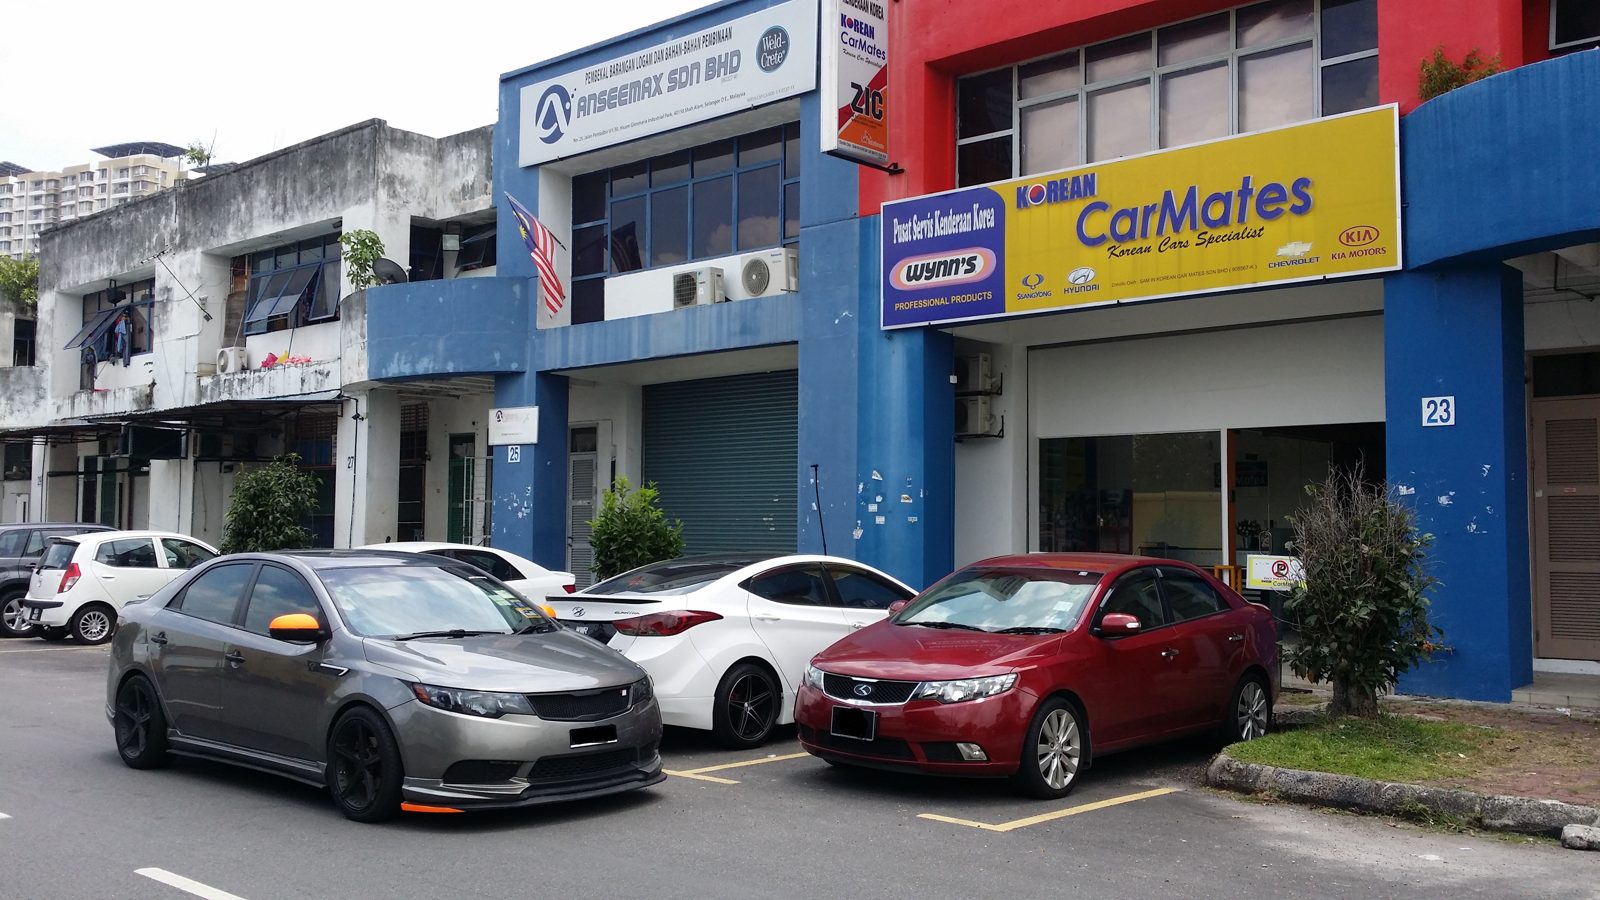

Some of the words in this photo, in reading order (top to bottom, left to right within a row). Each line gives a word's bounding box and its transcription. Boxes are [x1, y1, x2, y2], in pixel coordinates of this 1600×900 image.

[870, 1, 884, 20] KOREA
[841, 13, 875, 40] KOREAN
[762, 32, 786, 51] Weld-
[841, 31, 886, 60] CarMates
[585, 65, 608, 85] PEMBEKAL
[610, 57, 636, 78] BARANGAN
[636, 53, 651, 69] LOGAM
[654, 48, 664, 65] DAN
[665, 38, 701, 61] BAHAN-BAHAN
[702, 26, 733, 48] PEMBINAAN
[577, 72, 663, 119] ANSEEMAX
[667, 61, 701, 93] SDN
[704, 49, 741, 81] BHD
[850, 81, 883, 120] ZIC
[1016, 173, 1096, 209] KOREAN
[893, 218, 911, 244] Pusat
[913, 213, 934, 240] Servis
[934, 208, 971, 237] Kenderaan
[973, 203, 995, 231] Korea
[1076, 175, 1313, 247] CarMates
[1107, 242, 1152, 260] Korean
[1158, 237, 1189, 253] Cars
[1195, 226, 1265, 248] Specialist
[1346, 229, 1373, 243] KIA
[1268, 256, 1320, 269] CHEVROLET
[1331, 252, 1347, 260] KIA
[1349, 247, 1387, 258] MOTORS
[895, 297, 950, 311] PROFESSIONAL
[951, 291, 992, 304] PRODUCTS
[1064, 284, 1099, 294] HYUNDAI
[1427, 399, 1450, 423] 23
[510, 447, 519, 461] 25
